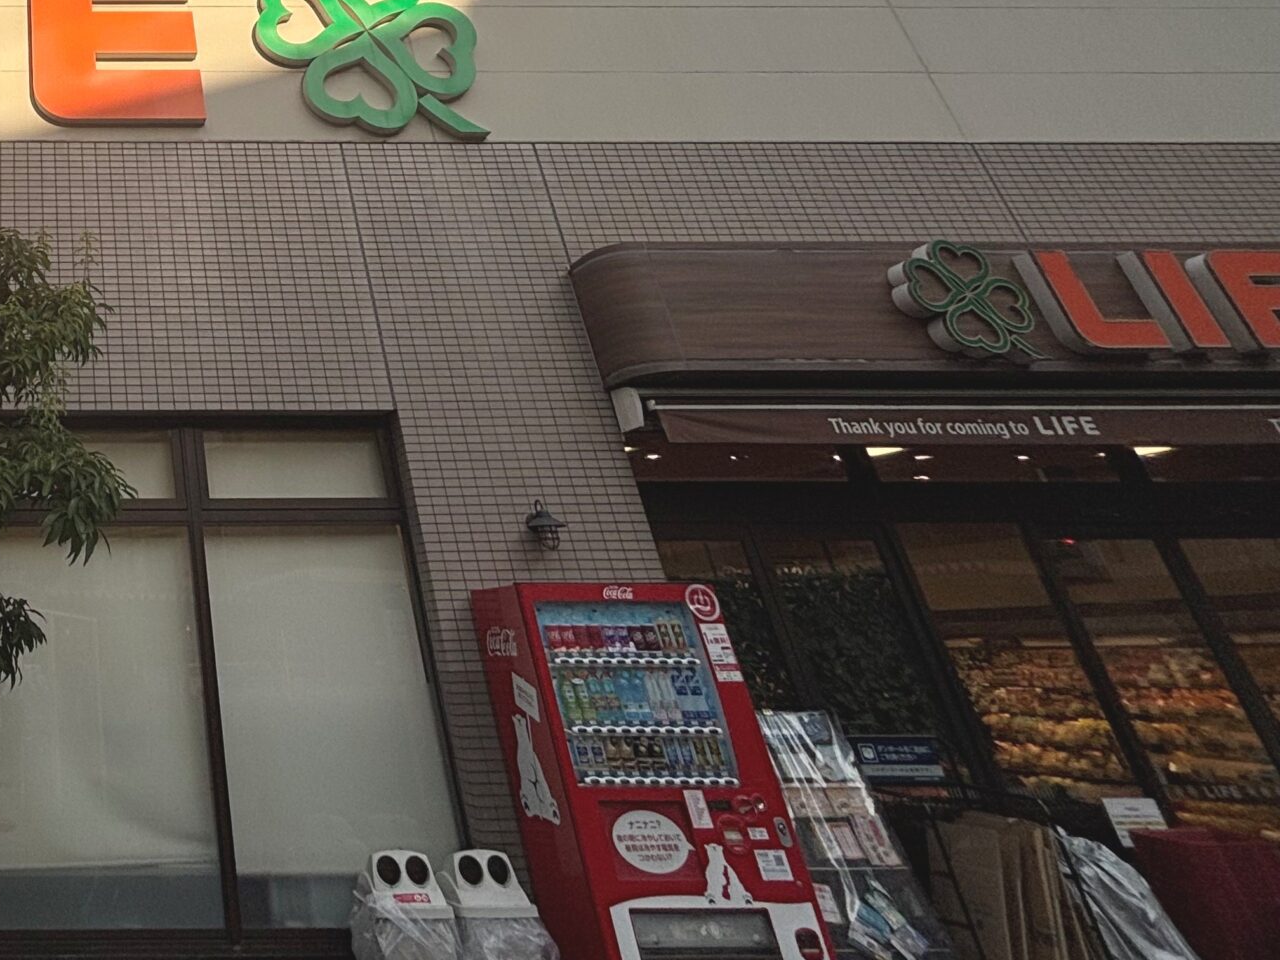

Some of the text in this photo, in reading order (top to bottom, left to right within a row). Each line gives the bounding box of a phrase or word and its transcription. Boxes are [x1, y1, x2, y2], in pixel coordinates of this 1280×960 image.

[827, 415, 1101, 439] Thank you for coming to LIFE
